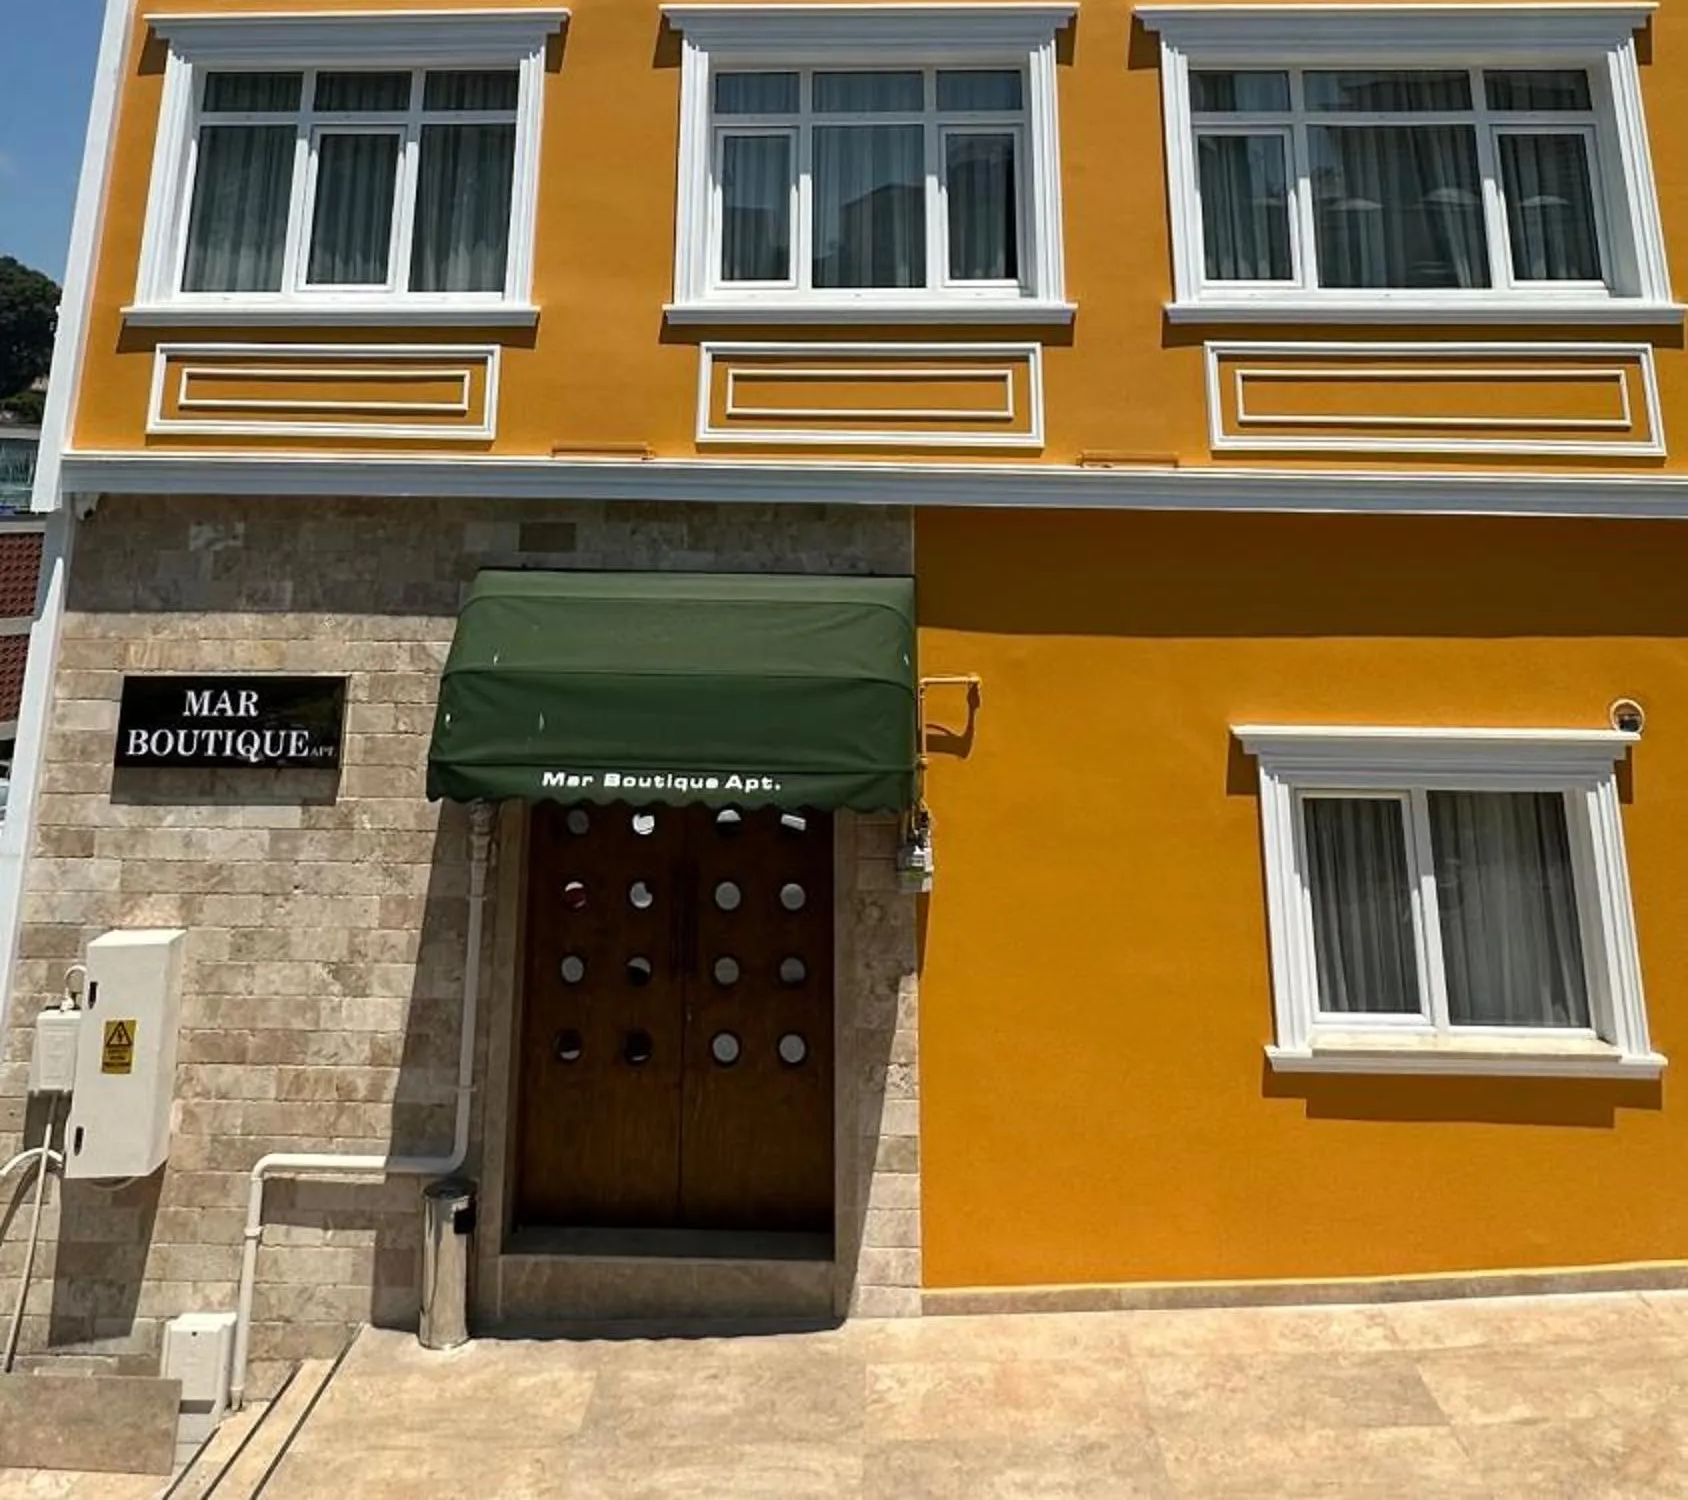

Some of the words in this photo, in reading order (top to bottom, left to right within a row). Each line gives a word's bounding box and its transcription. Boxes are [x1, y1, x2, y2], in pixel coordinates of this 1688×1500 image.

[183, 689, 259, 717] MAR
[125, 729, 309, 762] BOUTIQUE
[542, 772, 594, 788] Mar
[604, 773, 719, 792] Boutique
[724, 775, 781, 793] Apt.
